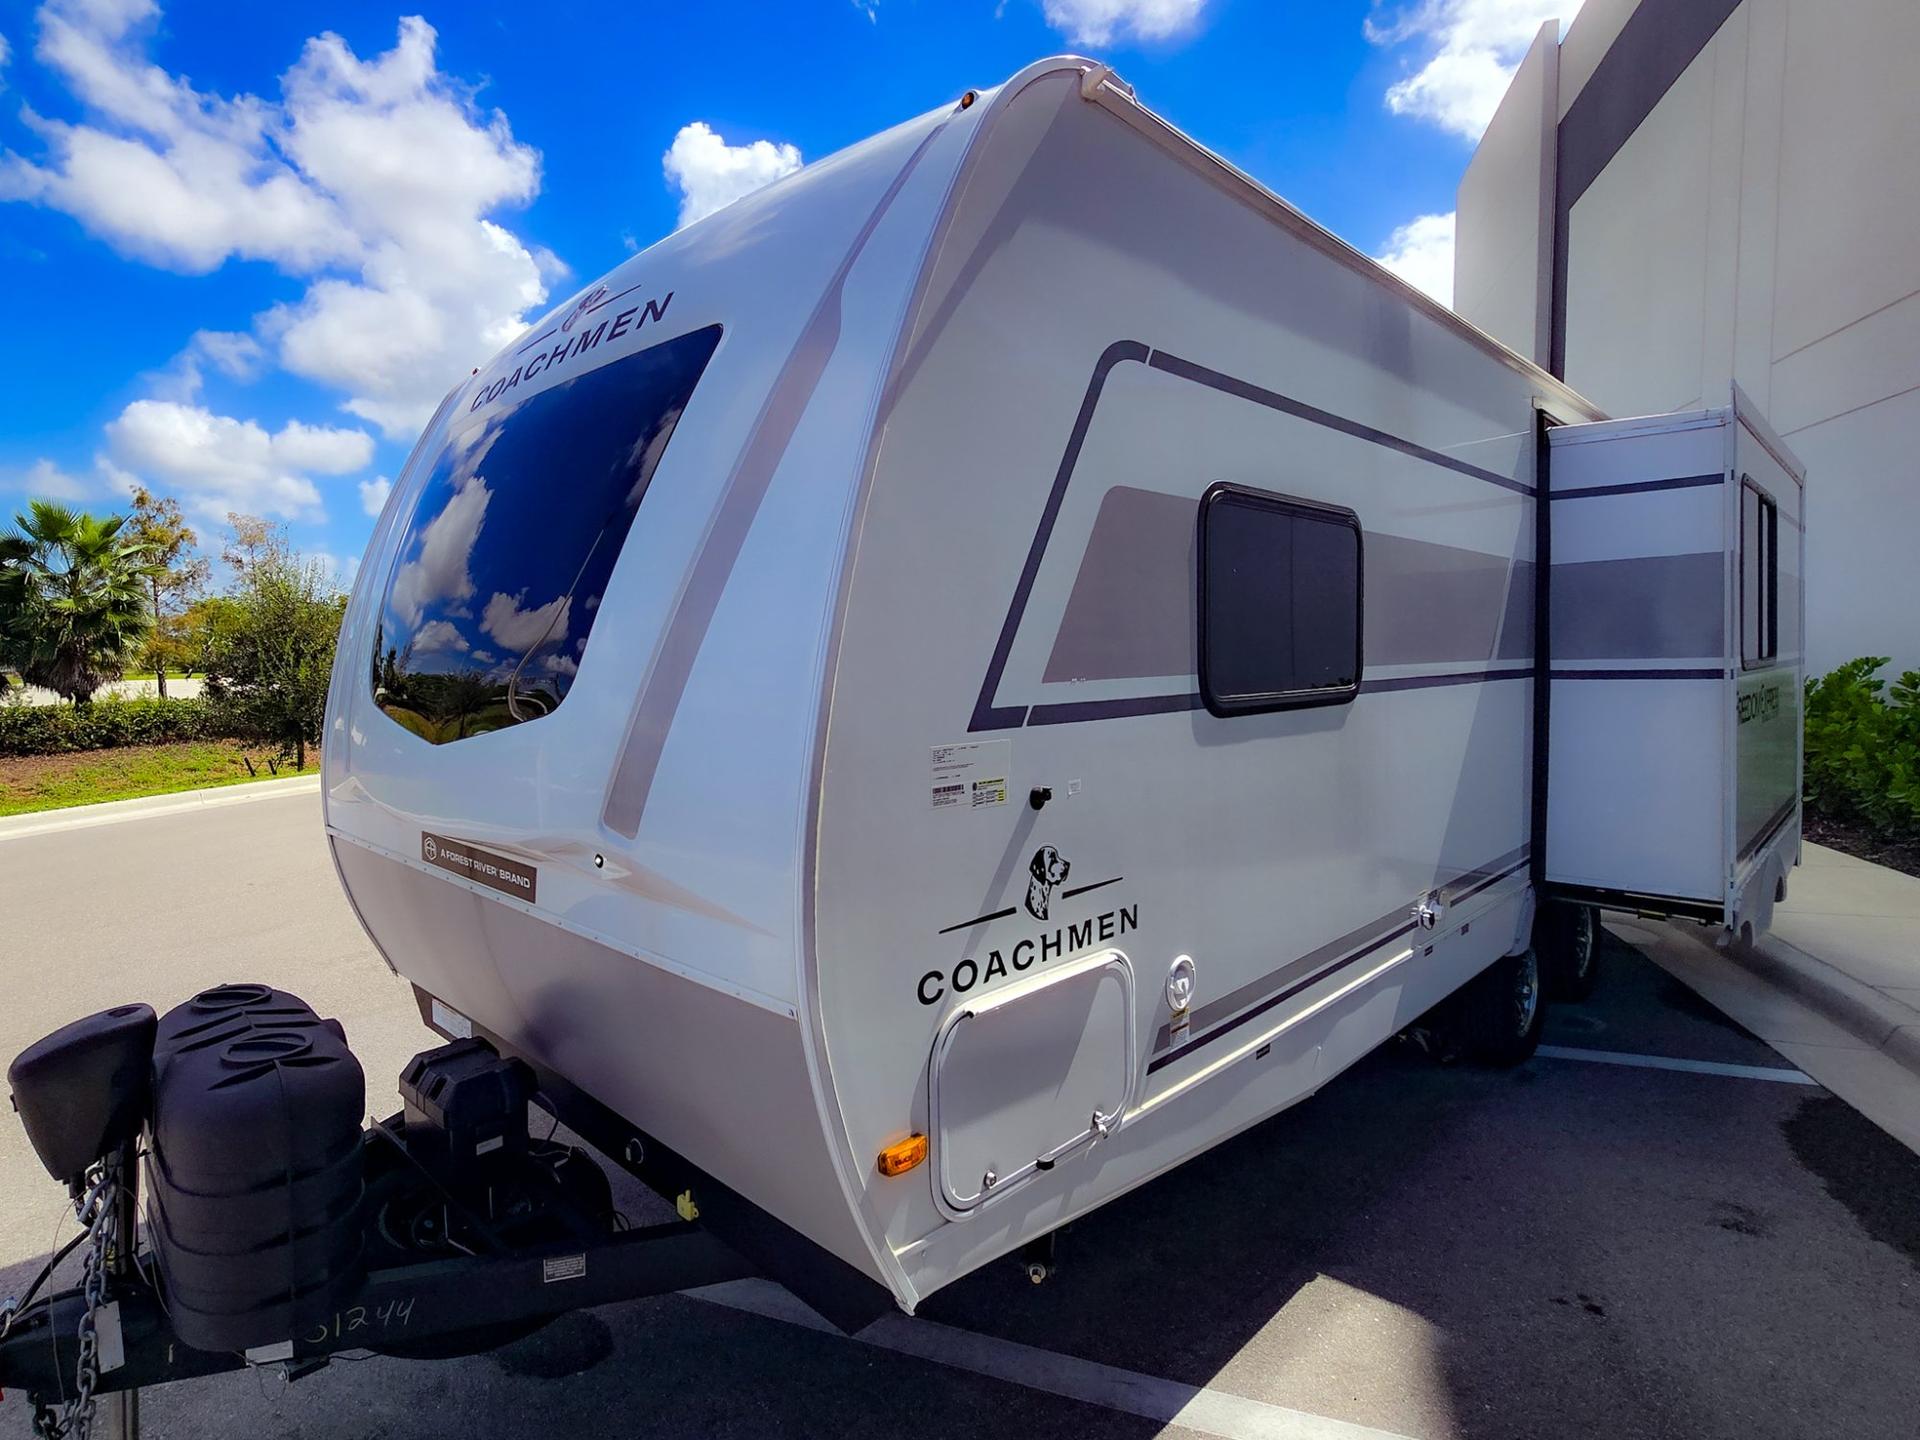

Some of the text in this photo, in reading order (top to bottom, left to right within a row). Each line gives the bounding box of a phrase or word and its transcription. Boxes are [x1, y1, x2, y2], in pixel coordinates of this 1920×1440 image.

[470, 291, 675, 413] COACHMEN
[440, 848, 531, 889] A FOREST RIVER BRAND
[917, 904, 1138, 1006] COACHMEN
